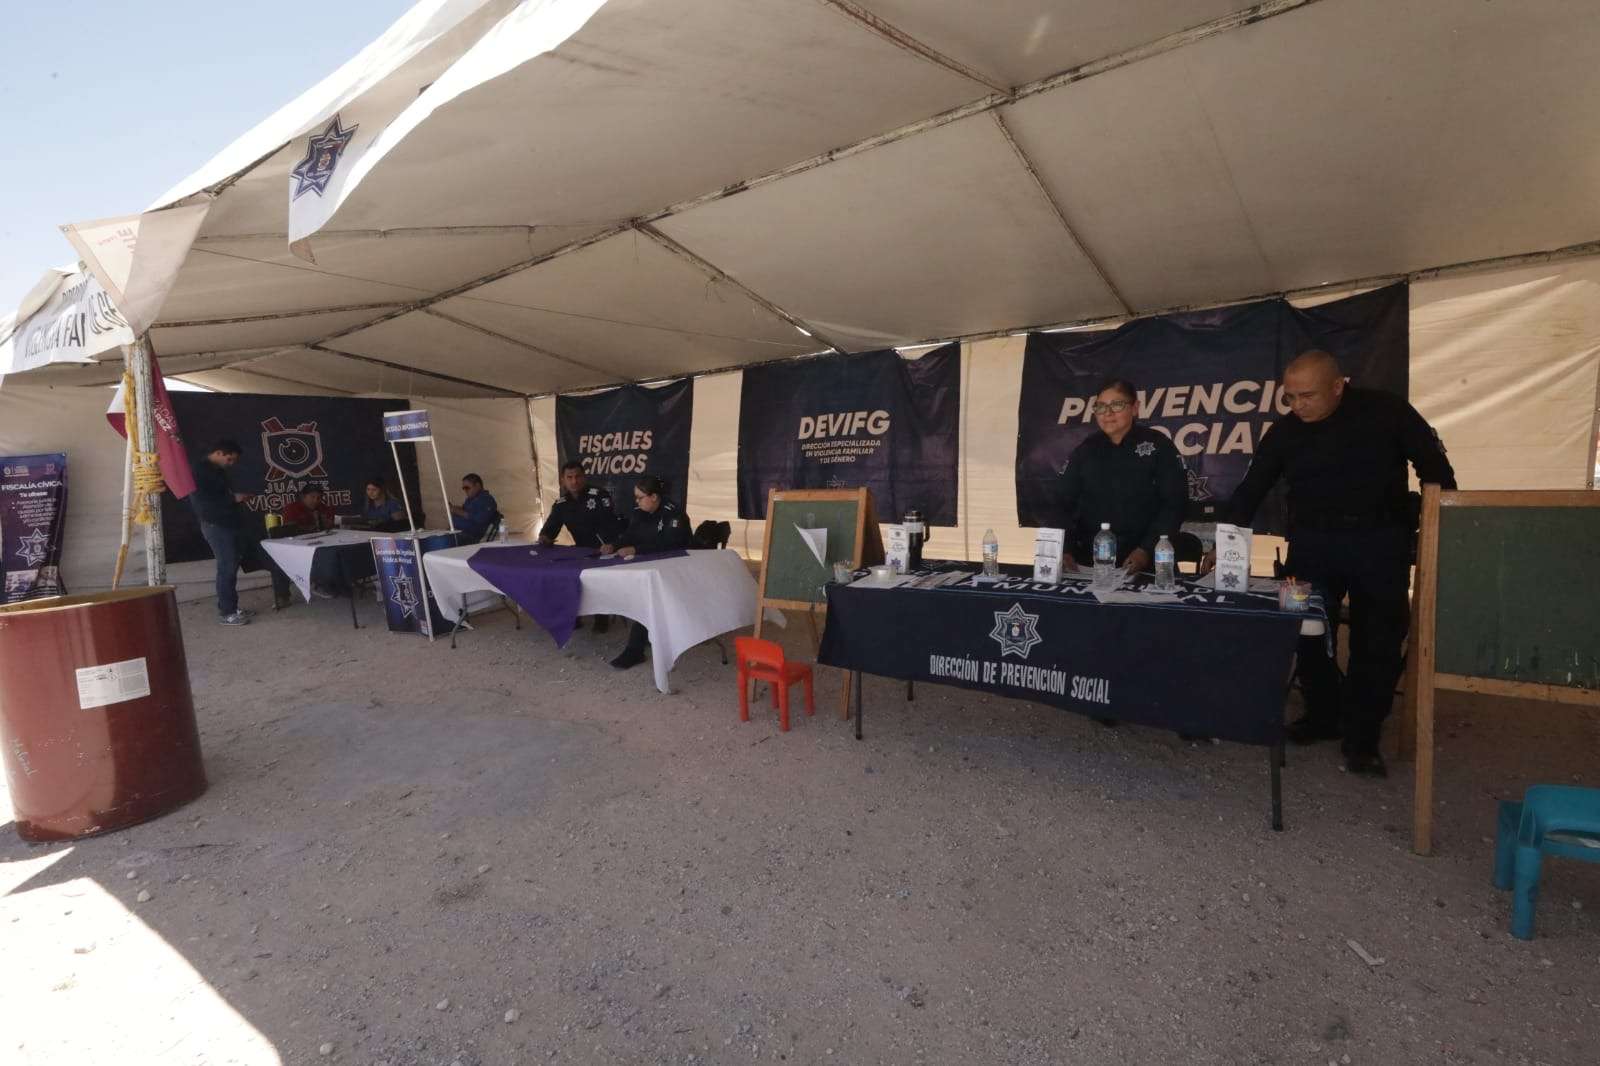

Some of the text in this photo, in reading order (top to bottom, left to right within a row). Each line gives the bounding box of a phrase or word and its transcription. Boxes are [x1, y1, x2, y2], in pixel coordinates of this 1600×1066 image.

[798, 410, 890, 440] DEVIFG
[579, 430, 653, 453] FISCALES
[842, 447, 874, 455] FAMILIAR
[581, 453, 648, 475] CÍVICOS
[1, 480, 63, 490] FISCALÍA CÍVICA
[930, 653, 1111, 704] DIRECCIÓN DE PREVENCIÓN SOCIAL
